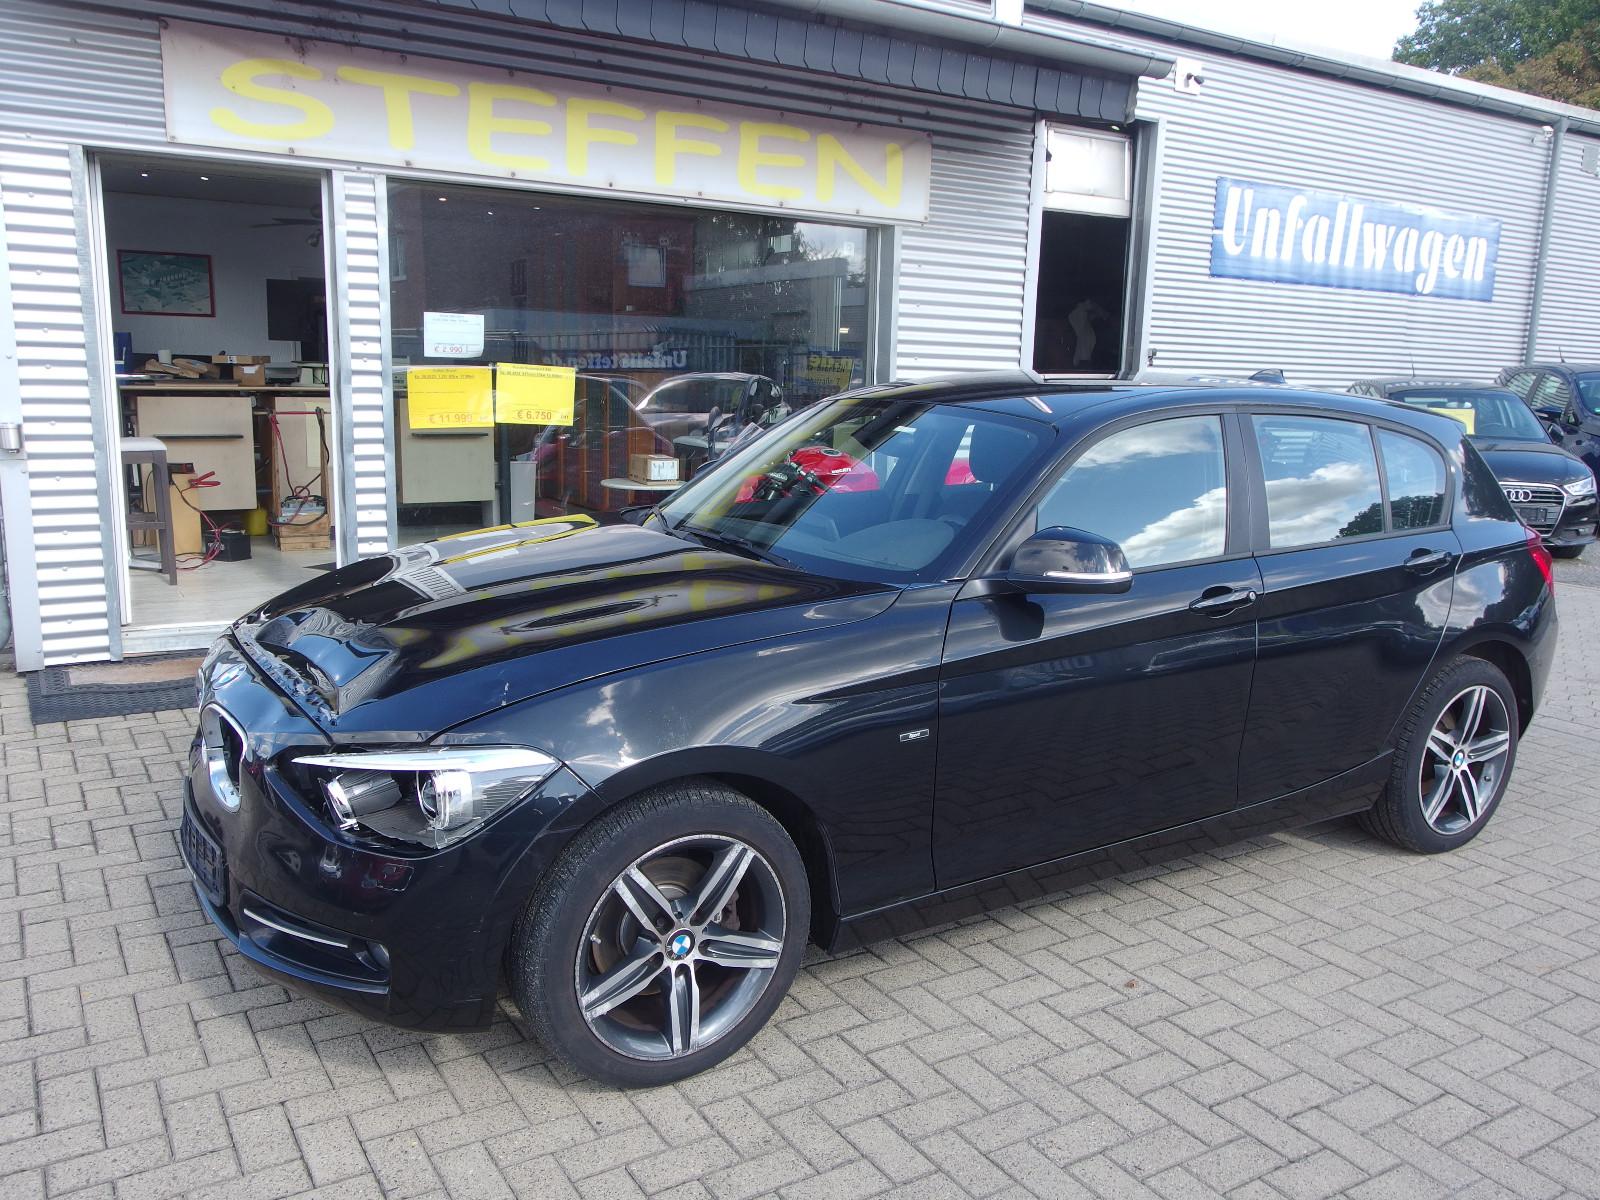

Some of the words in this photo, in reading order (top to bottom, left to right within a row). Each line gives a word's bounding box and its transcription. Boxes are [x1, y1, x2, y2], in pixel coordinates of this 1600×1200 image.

[210, 58, 904, 207] STEFFEN
[1222, 186, 1488, 295] Unfallwagen
[517, 410, 524, 419] €
[526, 410, 552, 420] 6.750
